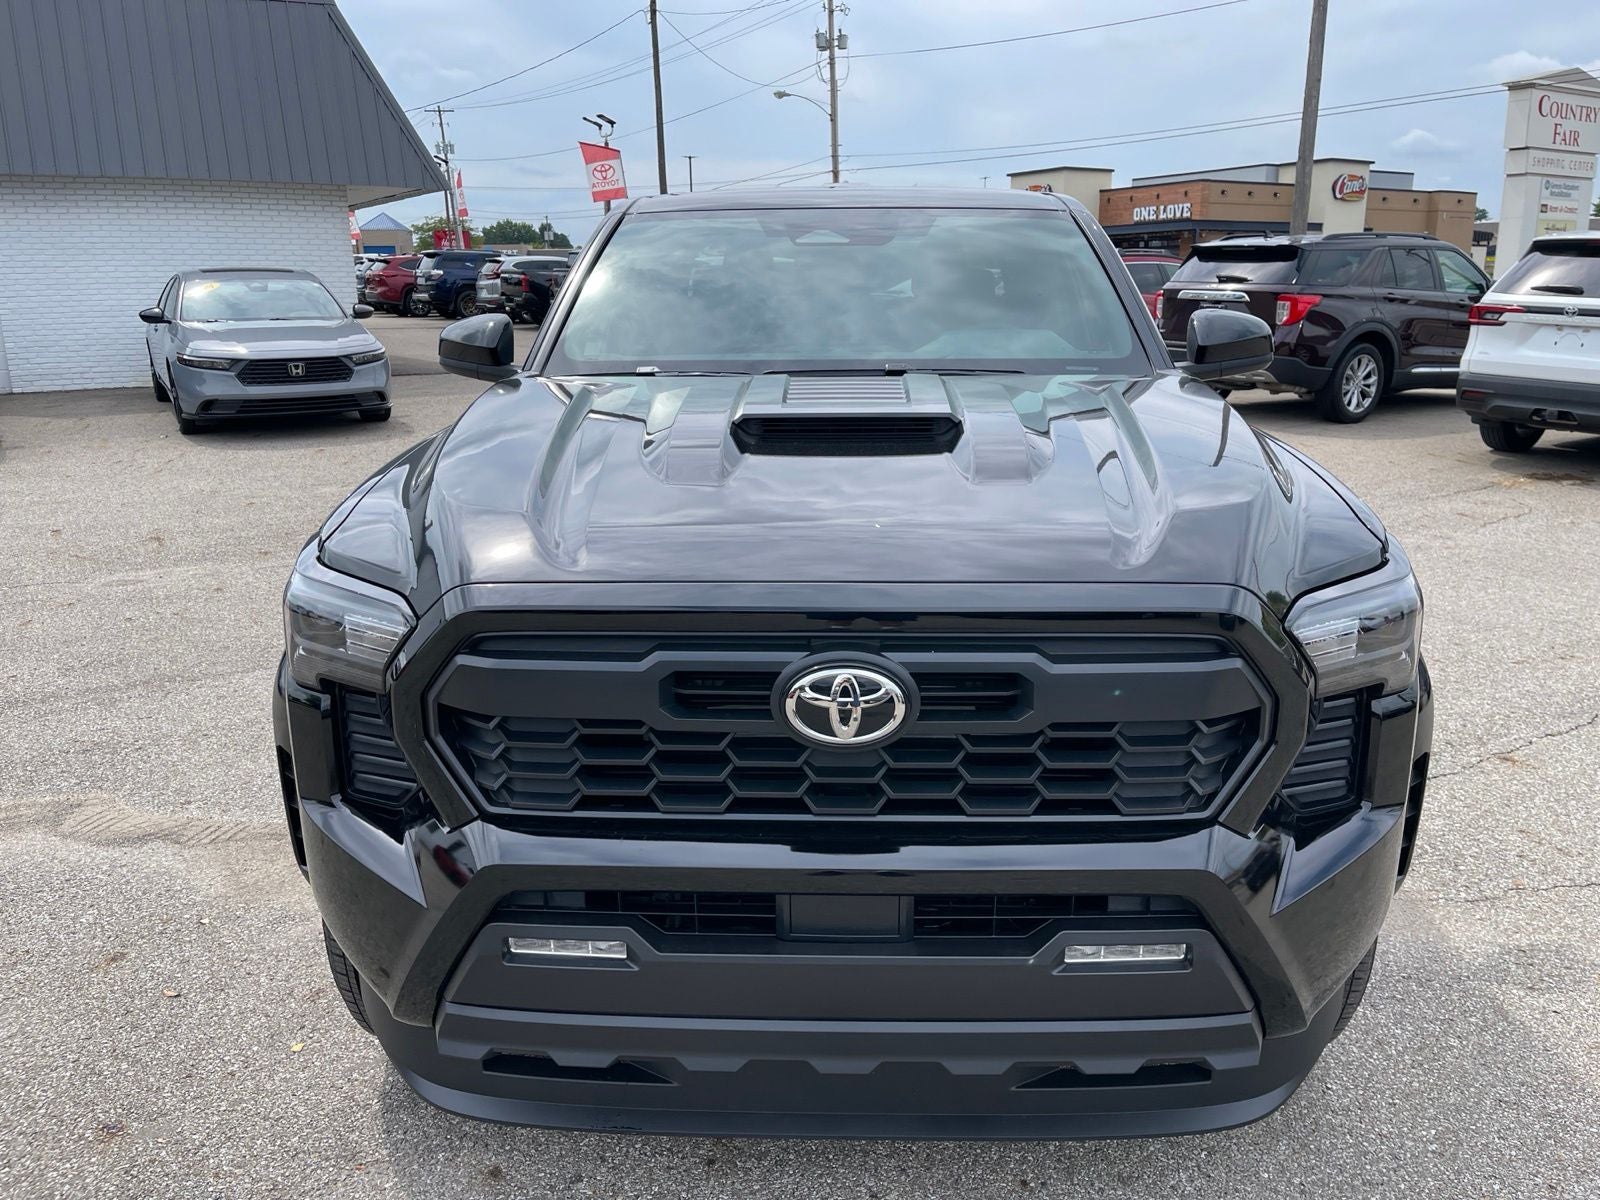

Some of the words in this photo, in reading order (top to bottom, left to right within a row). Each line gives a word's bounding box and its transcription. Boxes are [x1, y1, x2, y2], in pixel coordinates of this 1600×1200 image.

[1538, 94, 1600, 123] COUNTRY
[1552, 123, 1580, 147] FAIR
[1532, 157, 1565, 169] SHOPPING
[1569, 160, 1594, 172] CENTER
[1133, 206, 1157, 221] ONE
[1159, 202, 1191, 220] LOVE
